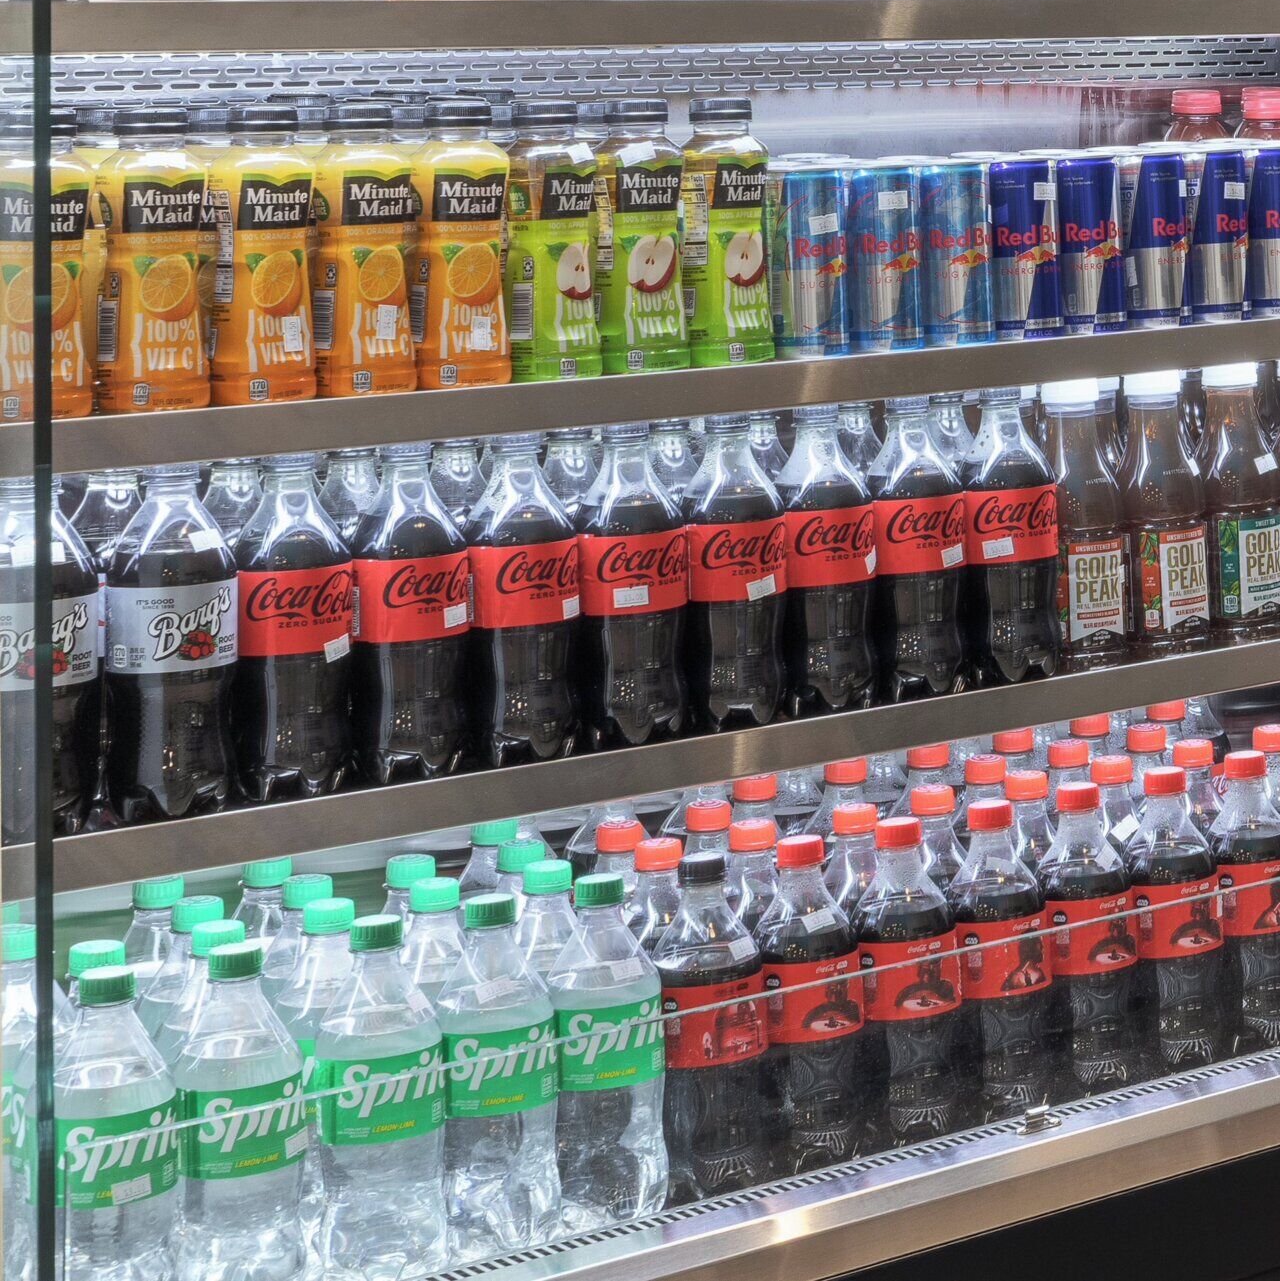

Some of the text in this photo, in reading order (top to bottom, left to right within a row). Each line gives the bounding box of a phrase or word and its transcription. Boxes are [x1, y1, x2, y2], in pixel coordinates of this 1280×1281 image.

[441, 181, 503, 199] Minute
[621, 172, 678, 190] Minute
[247, 188, 308, 206] Minute
[630, 187, 672, 205] Maid
[253, 206, 300, 222] Maid
[449, 197, 496, 215] Maid
[997, 227, 1038, 247] Red
[1065, 221, 1105, 242] Red
[146, 320, 195, 343] 100%
[146, 346, 194, 371] VIT C
[732, 568, 757, 576] ZERO
[1076, 554, 1121, 581] GOLD
[1076, 576, 1120, 603] PEAK
[147, 586, 231, 661] Barq's
